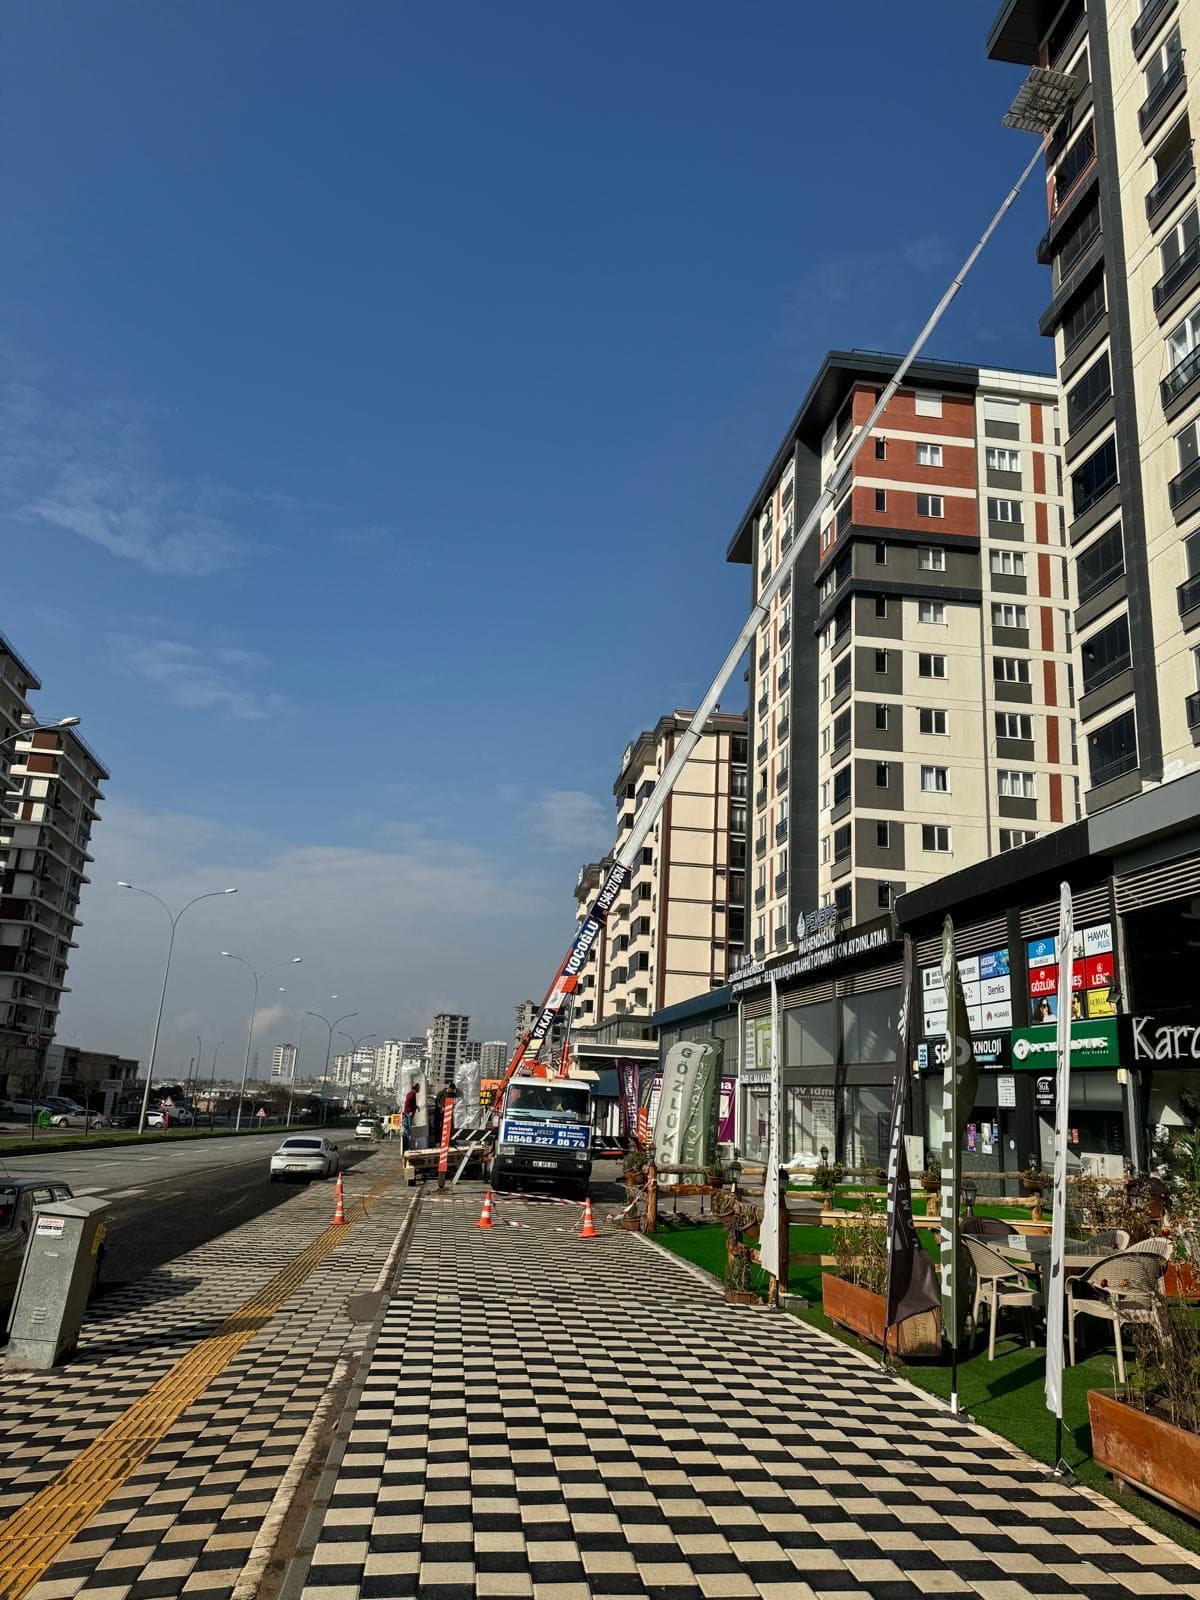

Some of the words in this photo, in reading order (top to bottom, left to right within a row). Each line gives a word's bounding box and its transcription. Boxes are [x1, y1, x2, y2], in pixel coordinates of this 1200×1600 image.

[605, 878, 620, 894] 227
[599, 890, 614, 905] 546
[848, 927, 888, 954] AYDINLATMA
[1087, 928, 1109, 943] HAWK
[565, 919, 599, 975] KOÇOĞLU
[1097, 939, 1111, 951] PLUS
[1031, 978, 1056, 993] GÖZLÜK
[538, 1011, 554, 1032] KAT
[533, 1024, 545, 1039] 16
[1038, 1081, 1050, 1091] SGK
[507, 1134, 532, 1143] 0546
[535, 1136, 554, 1145] 227
[557, 1138, 570, 1146] 06
[573, 1140, 586, 1148] 74
